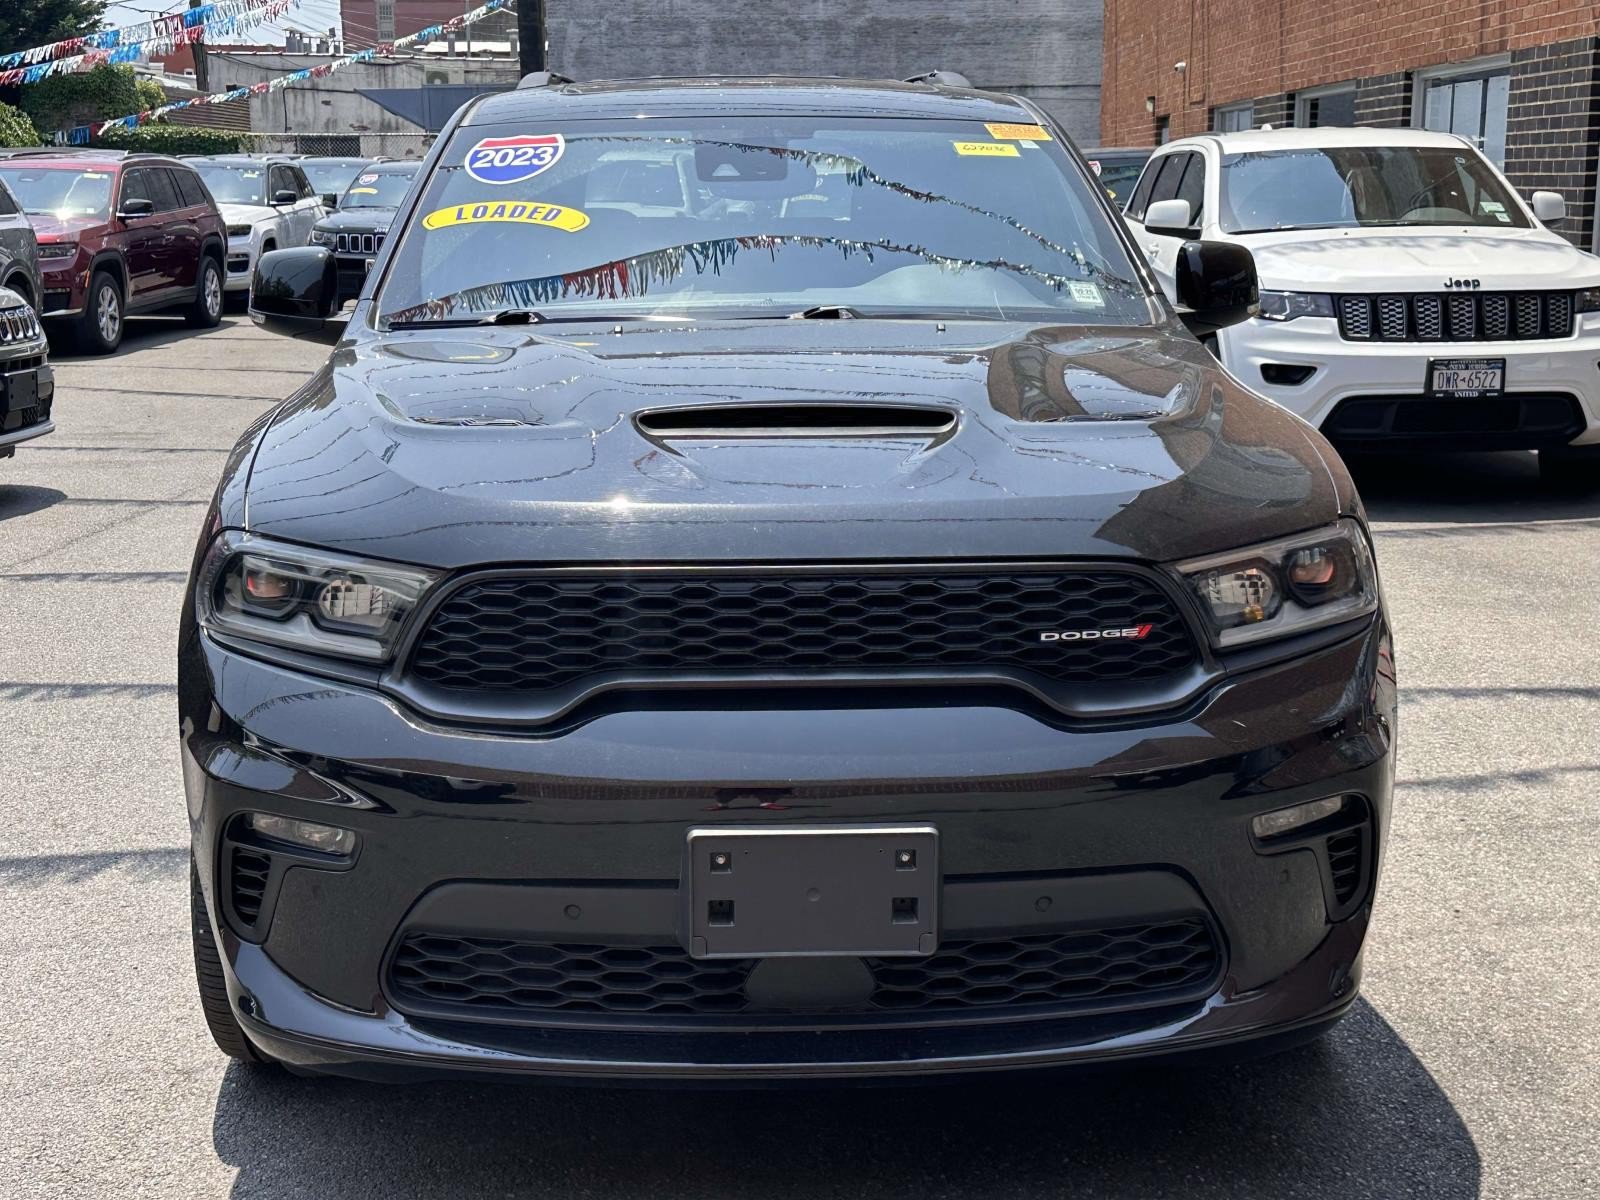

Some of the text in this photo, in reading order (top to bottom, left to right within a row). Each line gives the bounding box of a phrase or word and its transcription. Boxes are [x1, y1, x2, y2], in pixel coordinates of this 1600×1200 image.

[471, 146, 555, 169] 2023
[455, 204, 562, 222] LOADED
[1443, 276, 1481, 289] Jeep
[1040, 627, 1140, 641] DODGE
